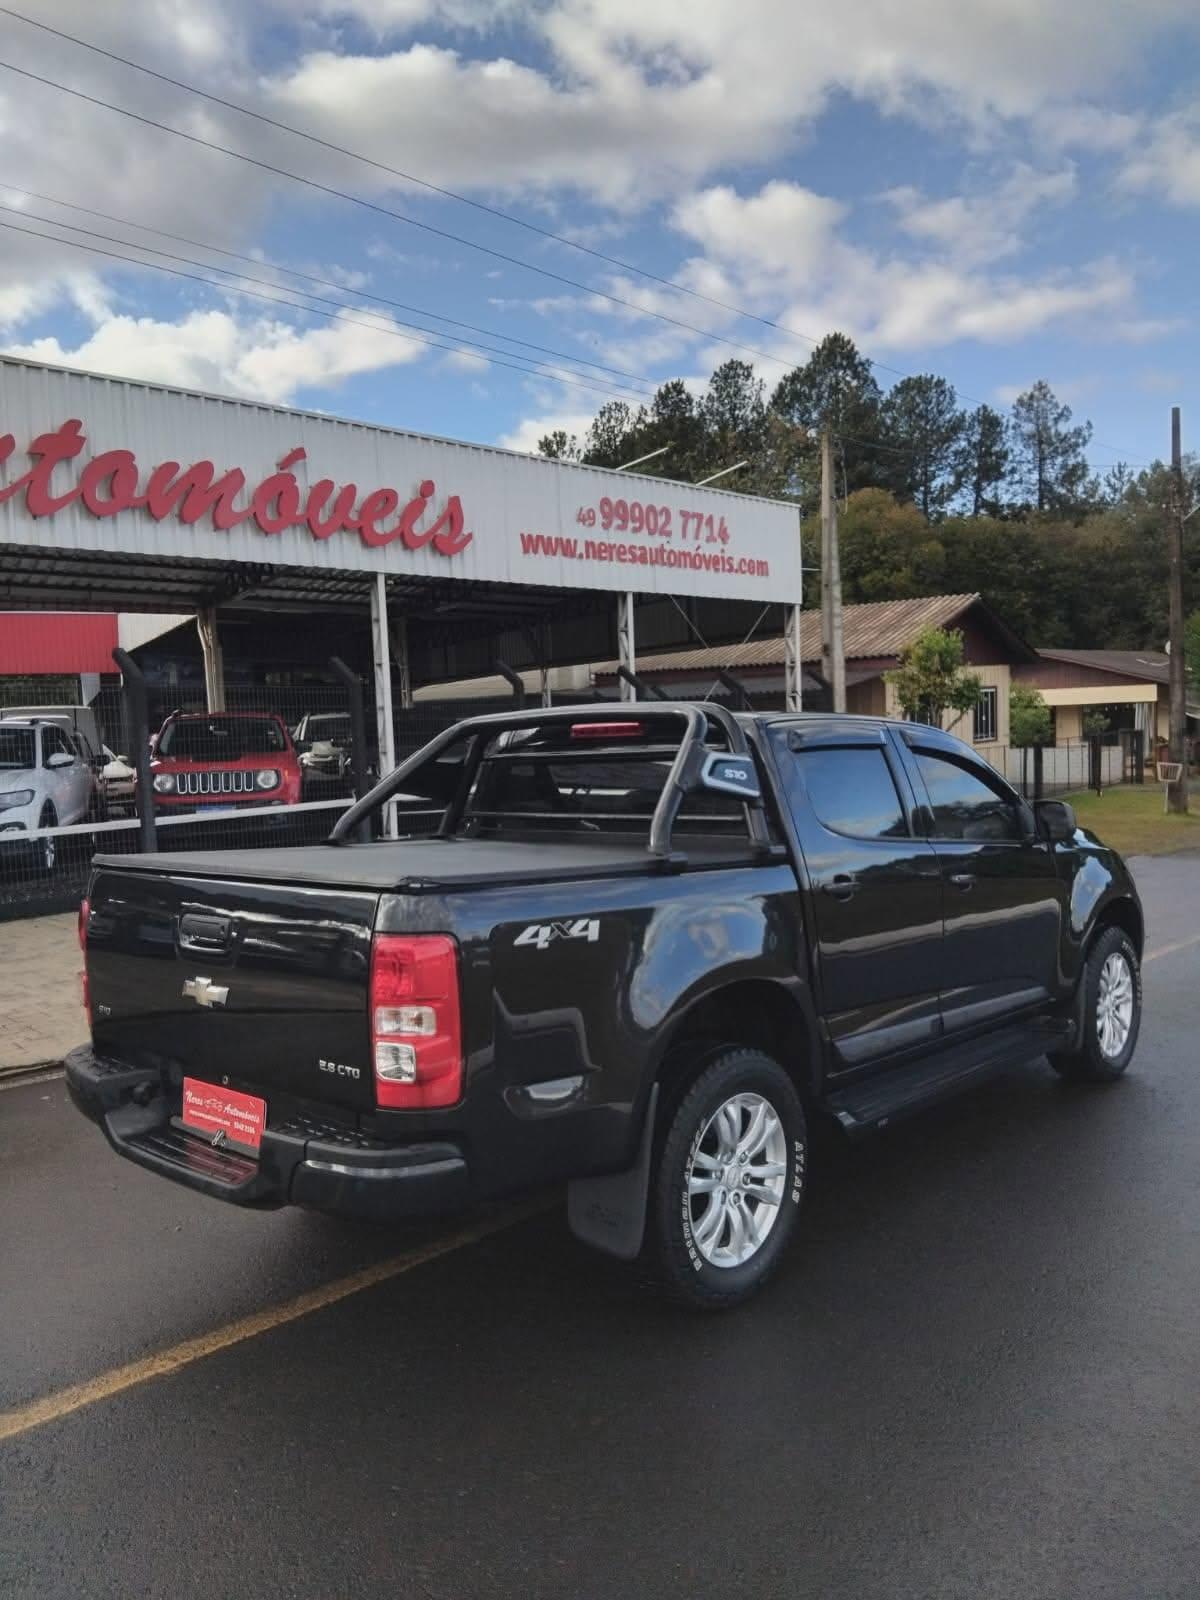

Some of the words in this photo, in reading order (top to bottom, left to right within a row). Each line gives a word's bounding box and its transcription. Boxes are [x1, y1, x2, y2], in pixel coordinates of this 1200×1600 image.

[575, 506, 596, 527] 49
[600, 496, 673, 538] 99902
[679, 509, 730, 545] 7714
[520, 532, 769, 577] www.neresautomóveis.com
[724, 768, 748, 780] S10
